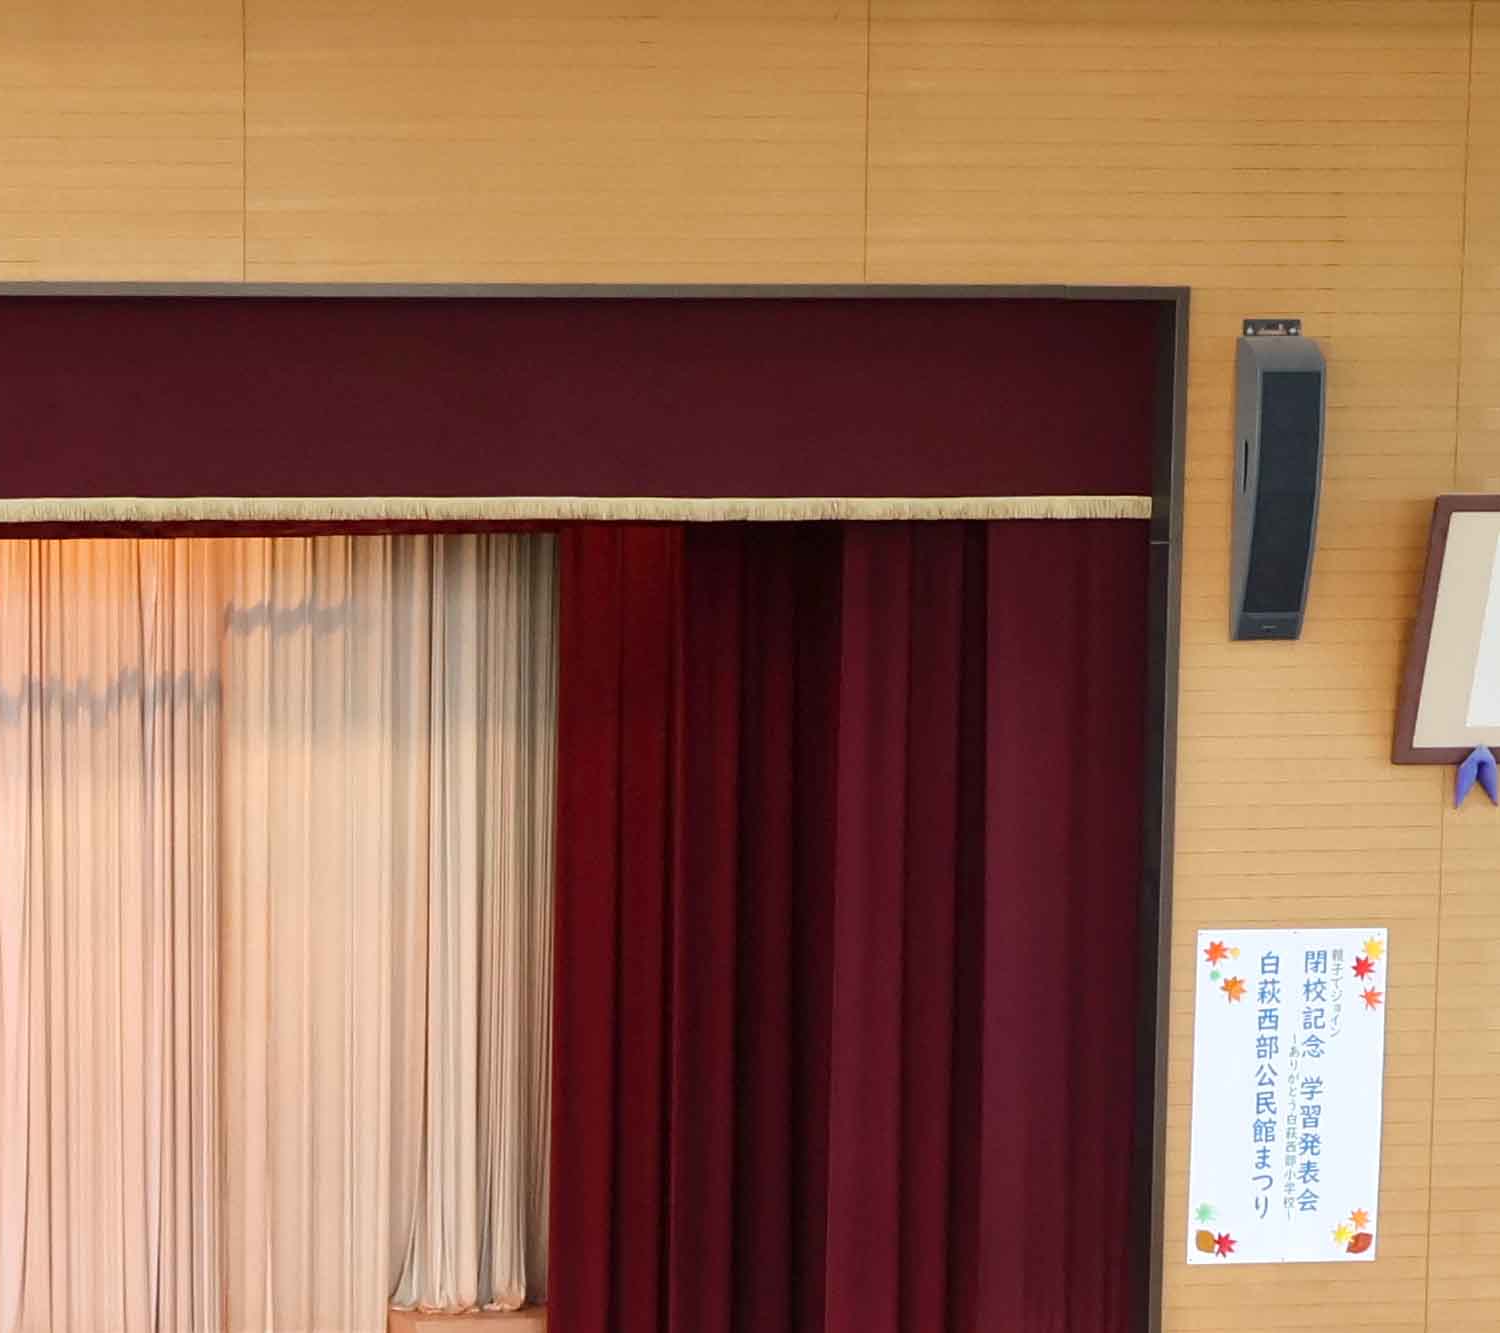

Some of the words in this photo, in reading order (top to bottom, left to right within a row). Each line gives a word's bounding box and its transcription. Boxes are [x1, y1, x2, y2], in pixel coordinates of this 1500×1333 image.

[1301, 950, 1328, 1059] 閉校記念
[1252, 951, 1281, 1220] 白萩西部公民館まつり
[1296, 1075, 1323, 1213] 学習発表会
